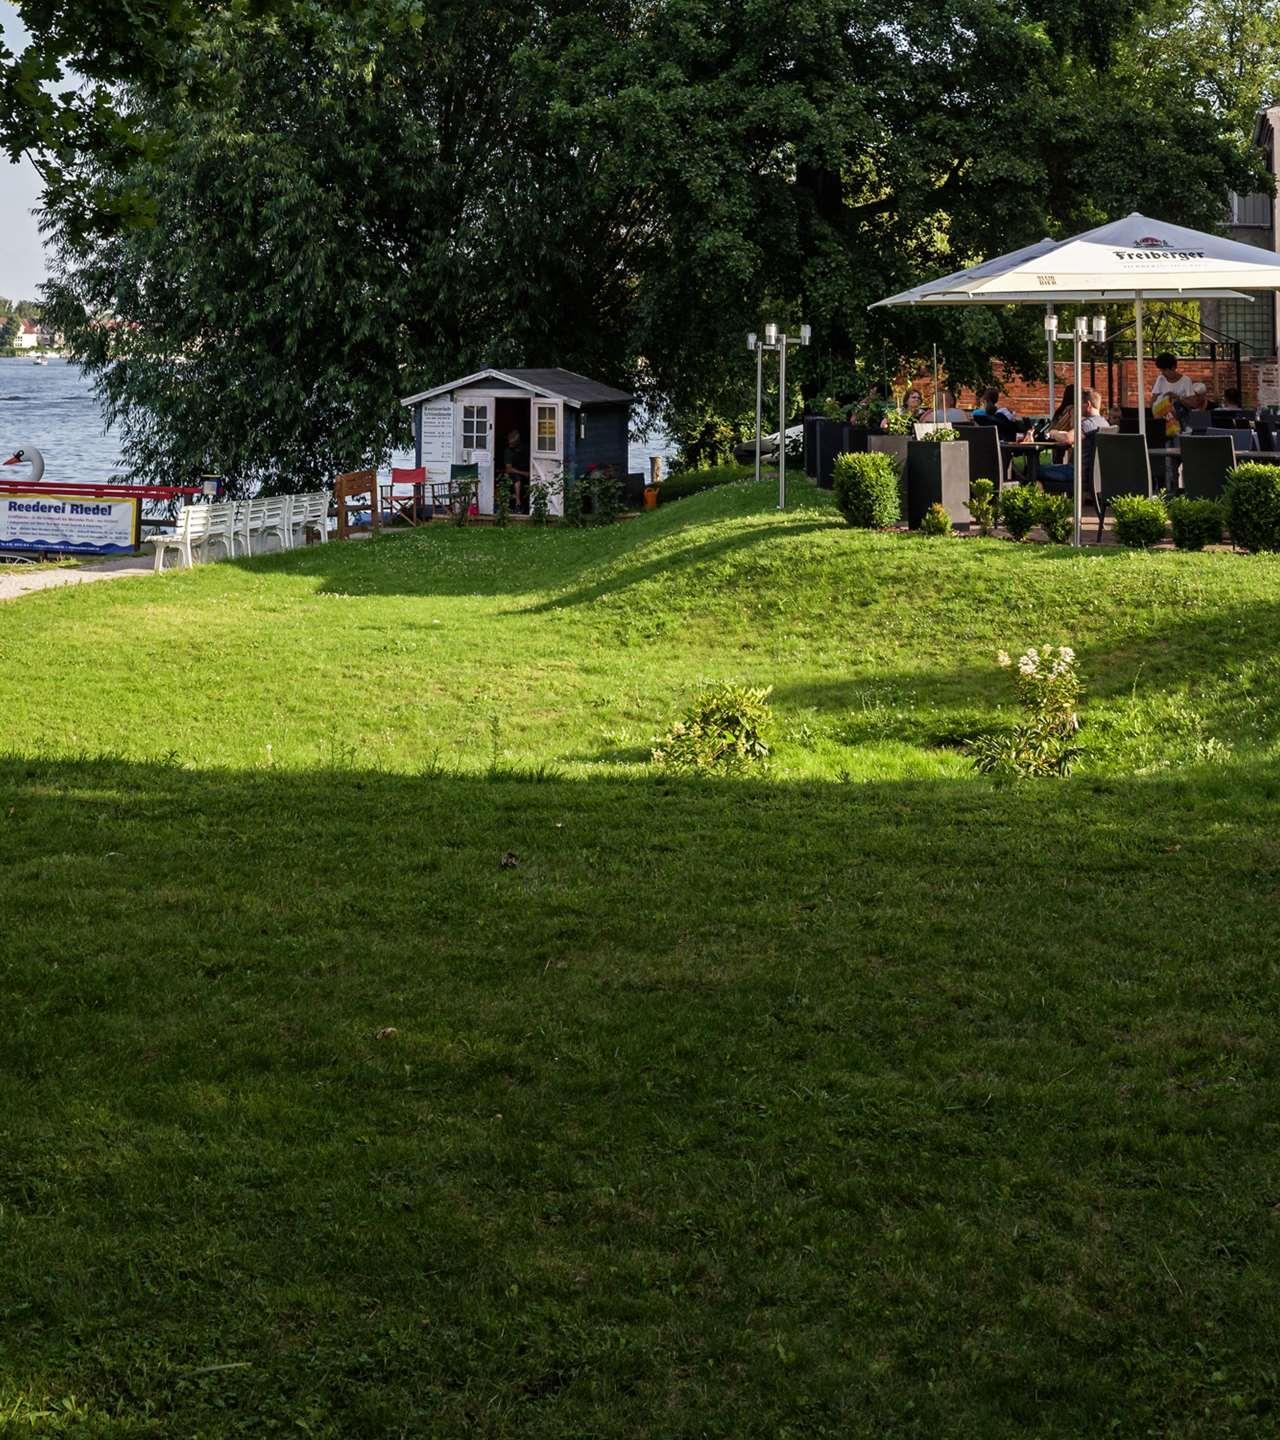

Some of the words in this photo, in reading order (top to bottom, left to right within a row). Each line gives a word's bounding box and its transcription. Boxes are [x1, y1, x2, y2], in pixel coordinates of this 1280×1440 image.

[1113, 251, 1206, 261] Freiberger
[8, 501, 66, 515] Reederei
[70, 503, 112, 516] Riedel
